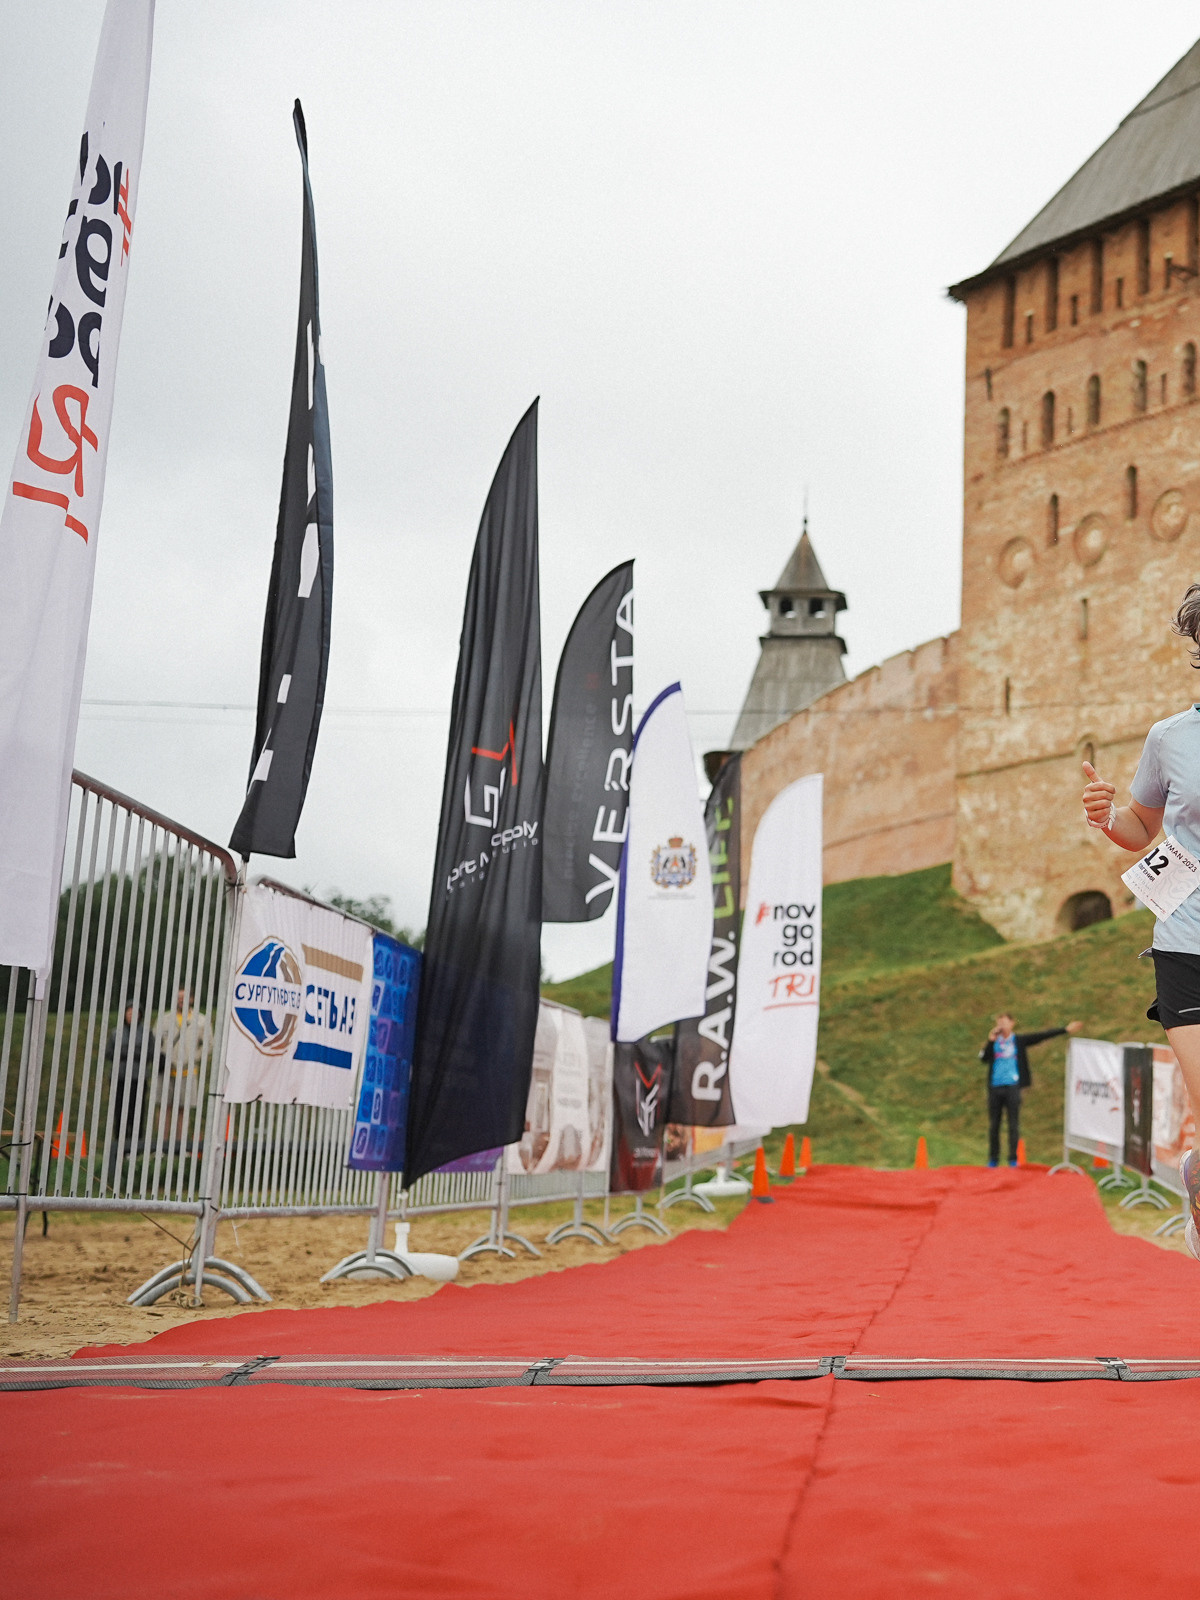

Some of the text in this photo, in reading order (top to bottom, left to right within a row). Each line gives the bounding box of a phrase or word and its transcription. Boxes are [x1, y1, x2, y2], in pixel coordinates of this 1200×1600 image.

[586, 588, 634, 905] VERSTA
[1143, 847, 1170, 876] 12
[1181, 857, 1198, 873] 2023
[782, 924, 814, 947] go
[772, 941, 814, 967] rod
[768, 973, 815, 998] TRI
